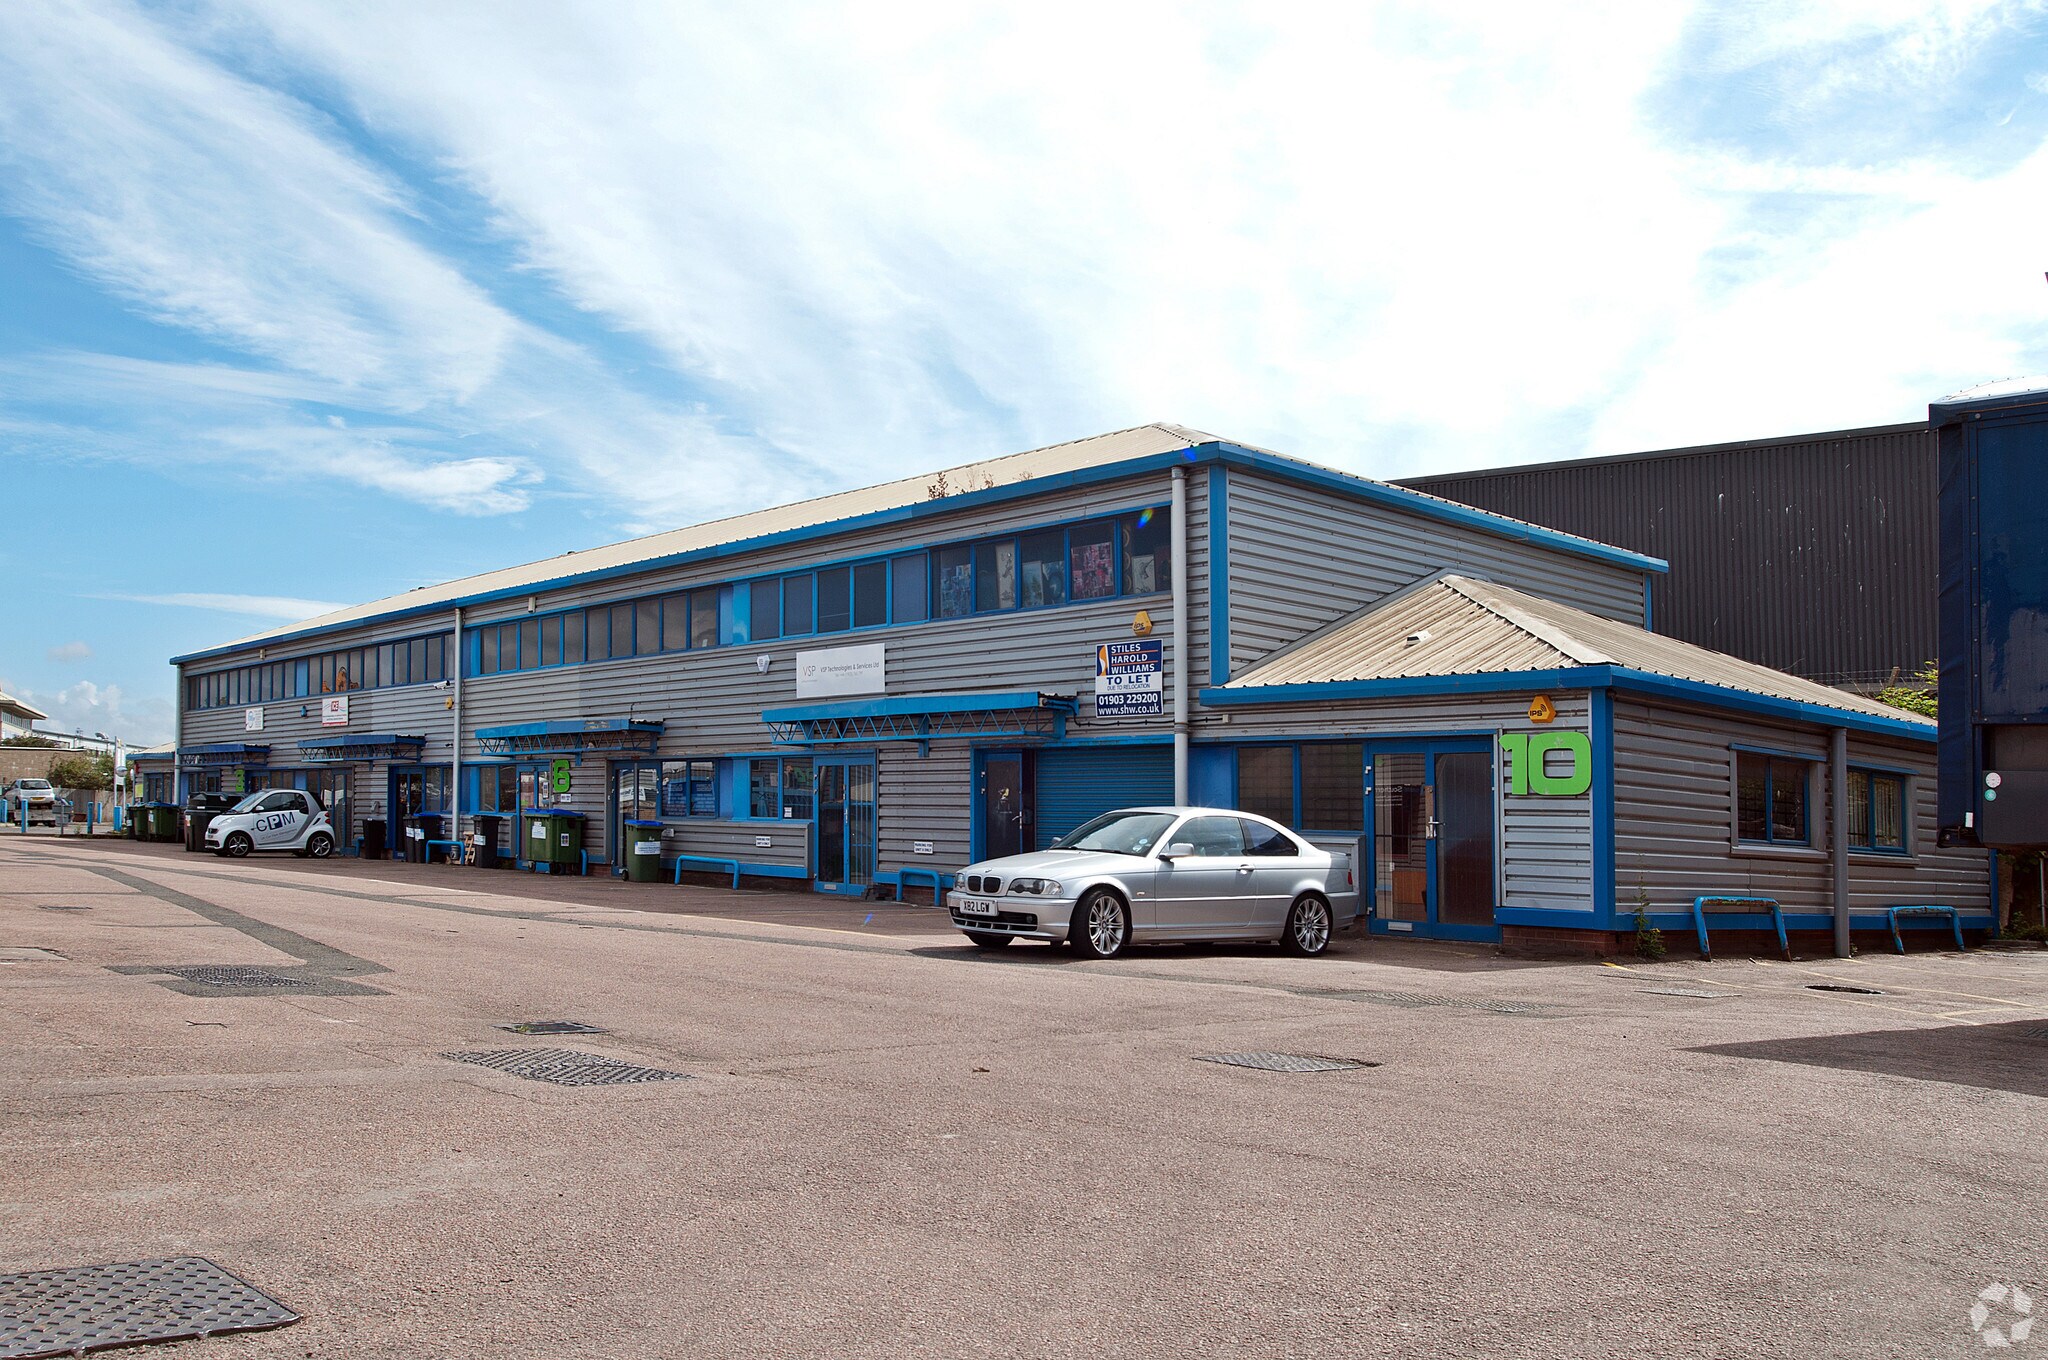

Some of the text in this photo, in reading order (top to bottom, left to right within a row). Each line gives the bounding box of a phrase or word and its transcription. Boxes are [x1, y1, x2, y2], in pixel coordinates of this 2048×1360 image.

[1111, 643, 1141, 654] STILES
[1111, 653, 1148, 664] HAROLD
[803, 665, 817, 677] VSP
[828, 663, 852, 672] Technologies
[1111, 663, 1155, 675] WILLIAMS
[1107, 674, 1151, 685] TO LET
[1099, 693, 1158, 705] 01903 229200
[1098, 703, 1160, 715] www.shw.co.uk
[1498, 732, 1592, 796] 10
[235, 770, 244, 792] 3
[554, 760, 570, 792] 6
[256, 812, 295, 831] CPM
[963, 901, 990, 912] X82 LGW
